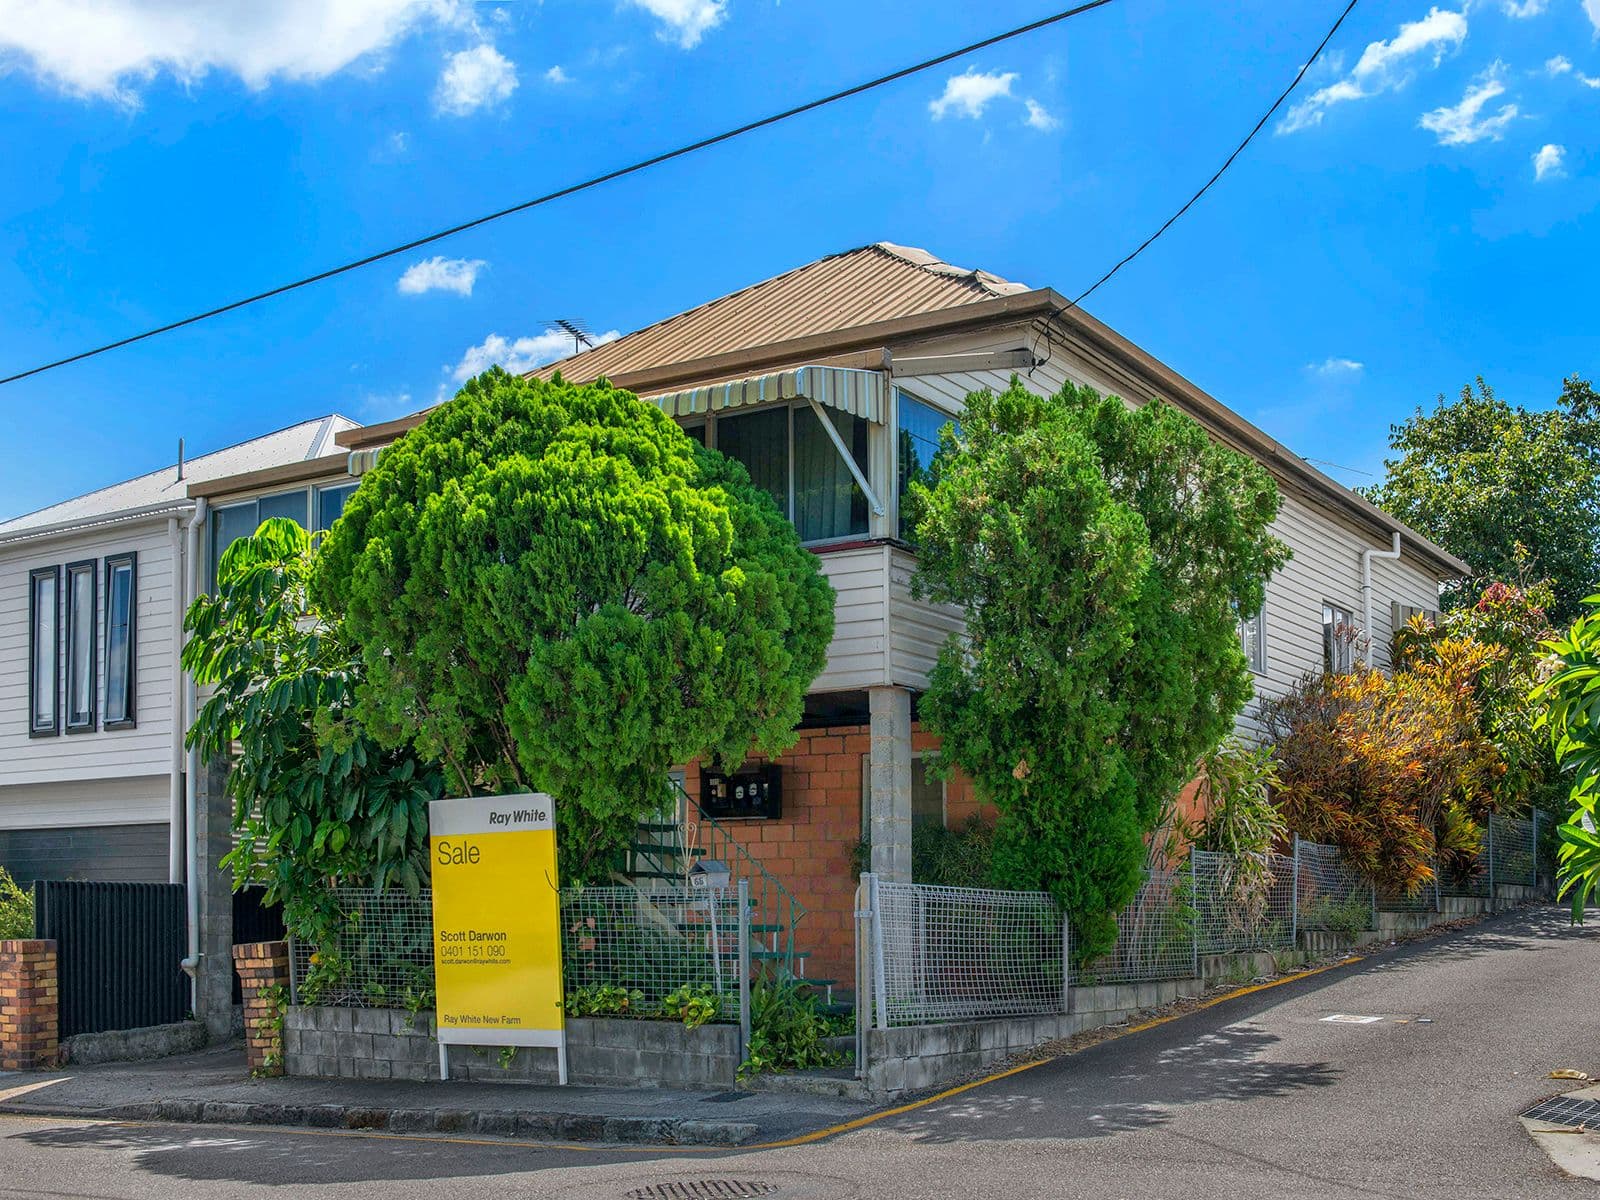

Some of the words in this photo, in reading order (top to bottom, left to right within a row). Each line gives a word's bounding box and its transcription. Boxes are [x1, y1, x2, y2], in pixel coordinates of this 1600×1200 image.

[489, 811, 511, 826] Ray
[513, 809, 546, 823] White
[438, 840, 480, 865] Sale
[441, 930, 466, 942] Scott
[468, 930, 507, 941] Darwon
[441, 945, 463, 957] 0401
[467, 945, 483, 957] 151
[486, 945, 505, 957] 090
[444, 1014, 459, 1025] Ray
[460, 1015, 481, 1024] White
[482, 1015, 500, 1024] New
[501, 1015, 521, 1025] Farm
